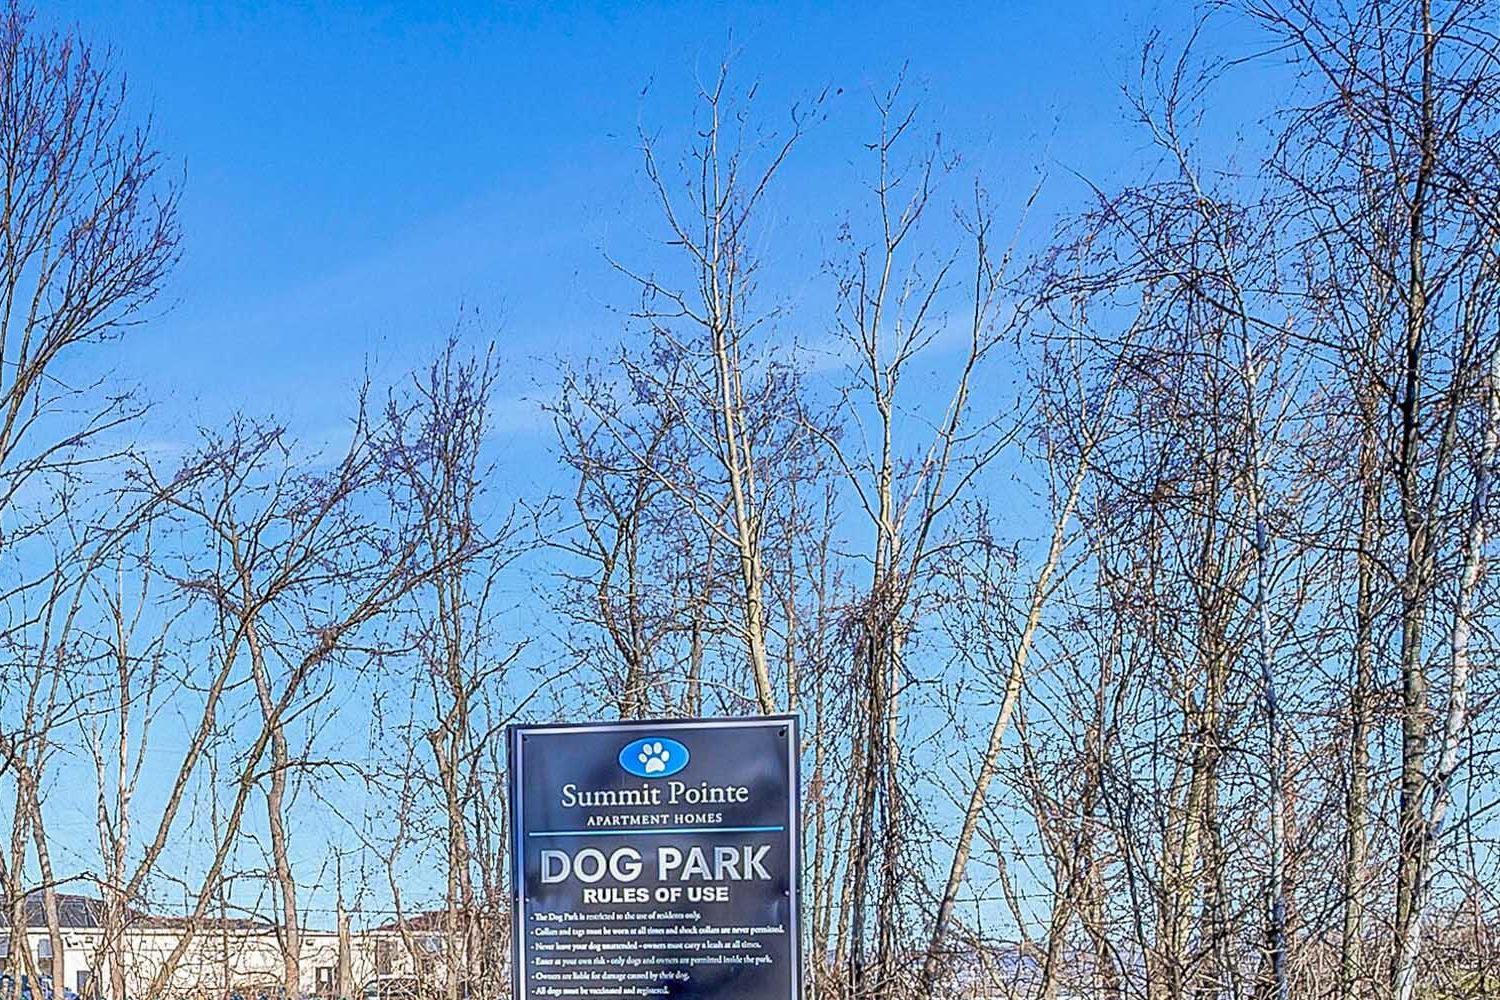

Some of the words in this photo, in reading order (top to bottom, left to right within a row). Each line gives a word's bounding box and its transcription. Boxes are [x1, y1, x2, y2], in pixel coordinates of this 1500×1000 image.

[561, 783, 661, 807] Summit
[668, 781, 749, 805] Pointe
[587, 814, 670, 826] APARTMENT
[674, 813, 723, 825] HOMES
[540, 847, 643, 884] DOG
[657, 845, 772, 881] PARK
[583, 887, 650, 904] RULES
[655, 887, 681, 902] OF
[688, 886, 729, 901] USE
[534, 912, 547, 921] The
[548, 912, 563, 923] Dog
[564, 912, 579, 921] Park
[586, 912, 615, 921] restricted
[624, 911, 636, 920] the
[648, 911, 656, 920] of
[656, 911, 684, 920] residents
[535, 927, 558, 936] Collars
[559, 927, 571, 935] and
[572, 928, 585, 938] tags
[603, 926, 611, 935] be
[638, 926, 646, 935] all
[647, 926, 664, 935] times
[665, 925, 678, 935] and
[679, 925, 698, 935] shock
[699, 925, 720, 934] collars
[750, 925, 785, 936] permitted.
[535, 942, 554, 951] Never
[556, 941, 571, 950] leave
[572, 943, 588, 952] your
[588, 941, 601, 952] dog
[602, 941, 638, 950] unattended
[684, 943, 701, 951] carry
[706, 940, 724, 949] leash
[732, 940, 741, 949] all
[741, 940, 762, 949] times.
[535, 957, 553, 965] Enter
[562, 959, 577, 967] your
[610, 956, 625, 967] only
[626, 956, 641, 967] dogs
[642, 956, 655, 965] and
[690, 955, 722, 966] permitted
[723, 955, 743, 964] inside
[743, 955, 754, 964] the
[755, 954, 773, 966] park.
[535, 971, 561, 980] Owners
[572, 971, 590, 980] liable
[591, 971, 601, 980] for
[602, 971, 626, 982] damage
[627, 971, 649, 980] caused
[649, 971, 658, 982] by
[659, 971, 675, 979] their
[675, 971, 690, 982] dog.
[536, 986, 546, 995] All
[547, 986, 562, 997] dogs
[580, 986, 589, 995] be
[589, 986, 621, 995] vaccinated
[623, 986, 636, 995] and
[636, 986, 670, 996] registered.
